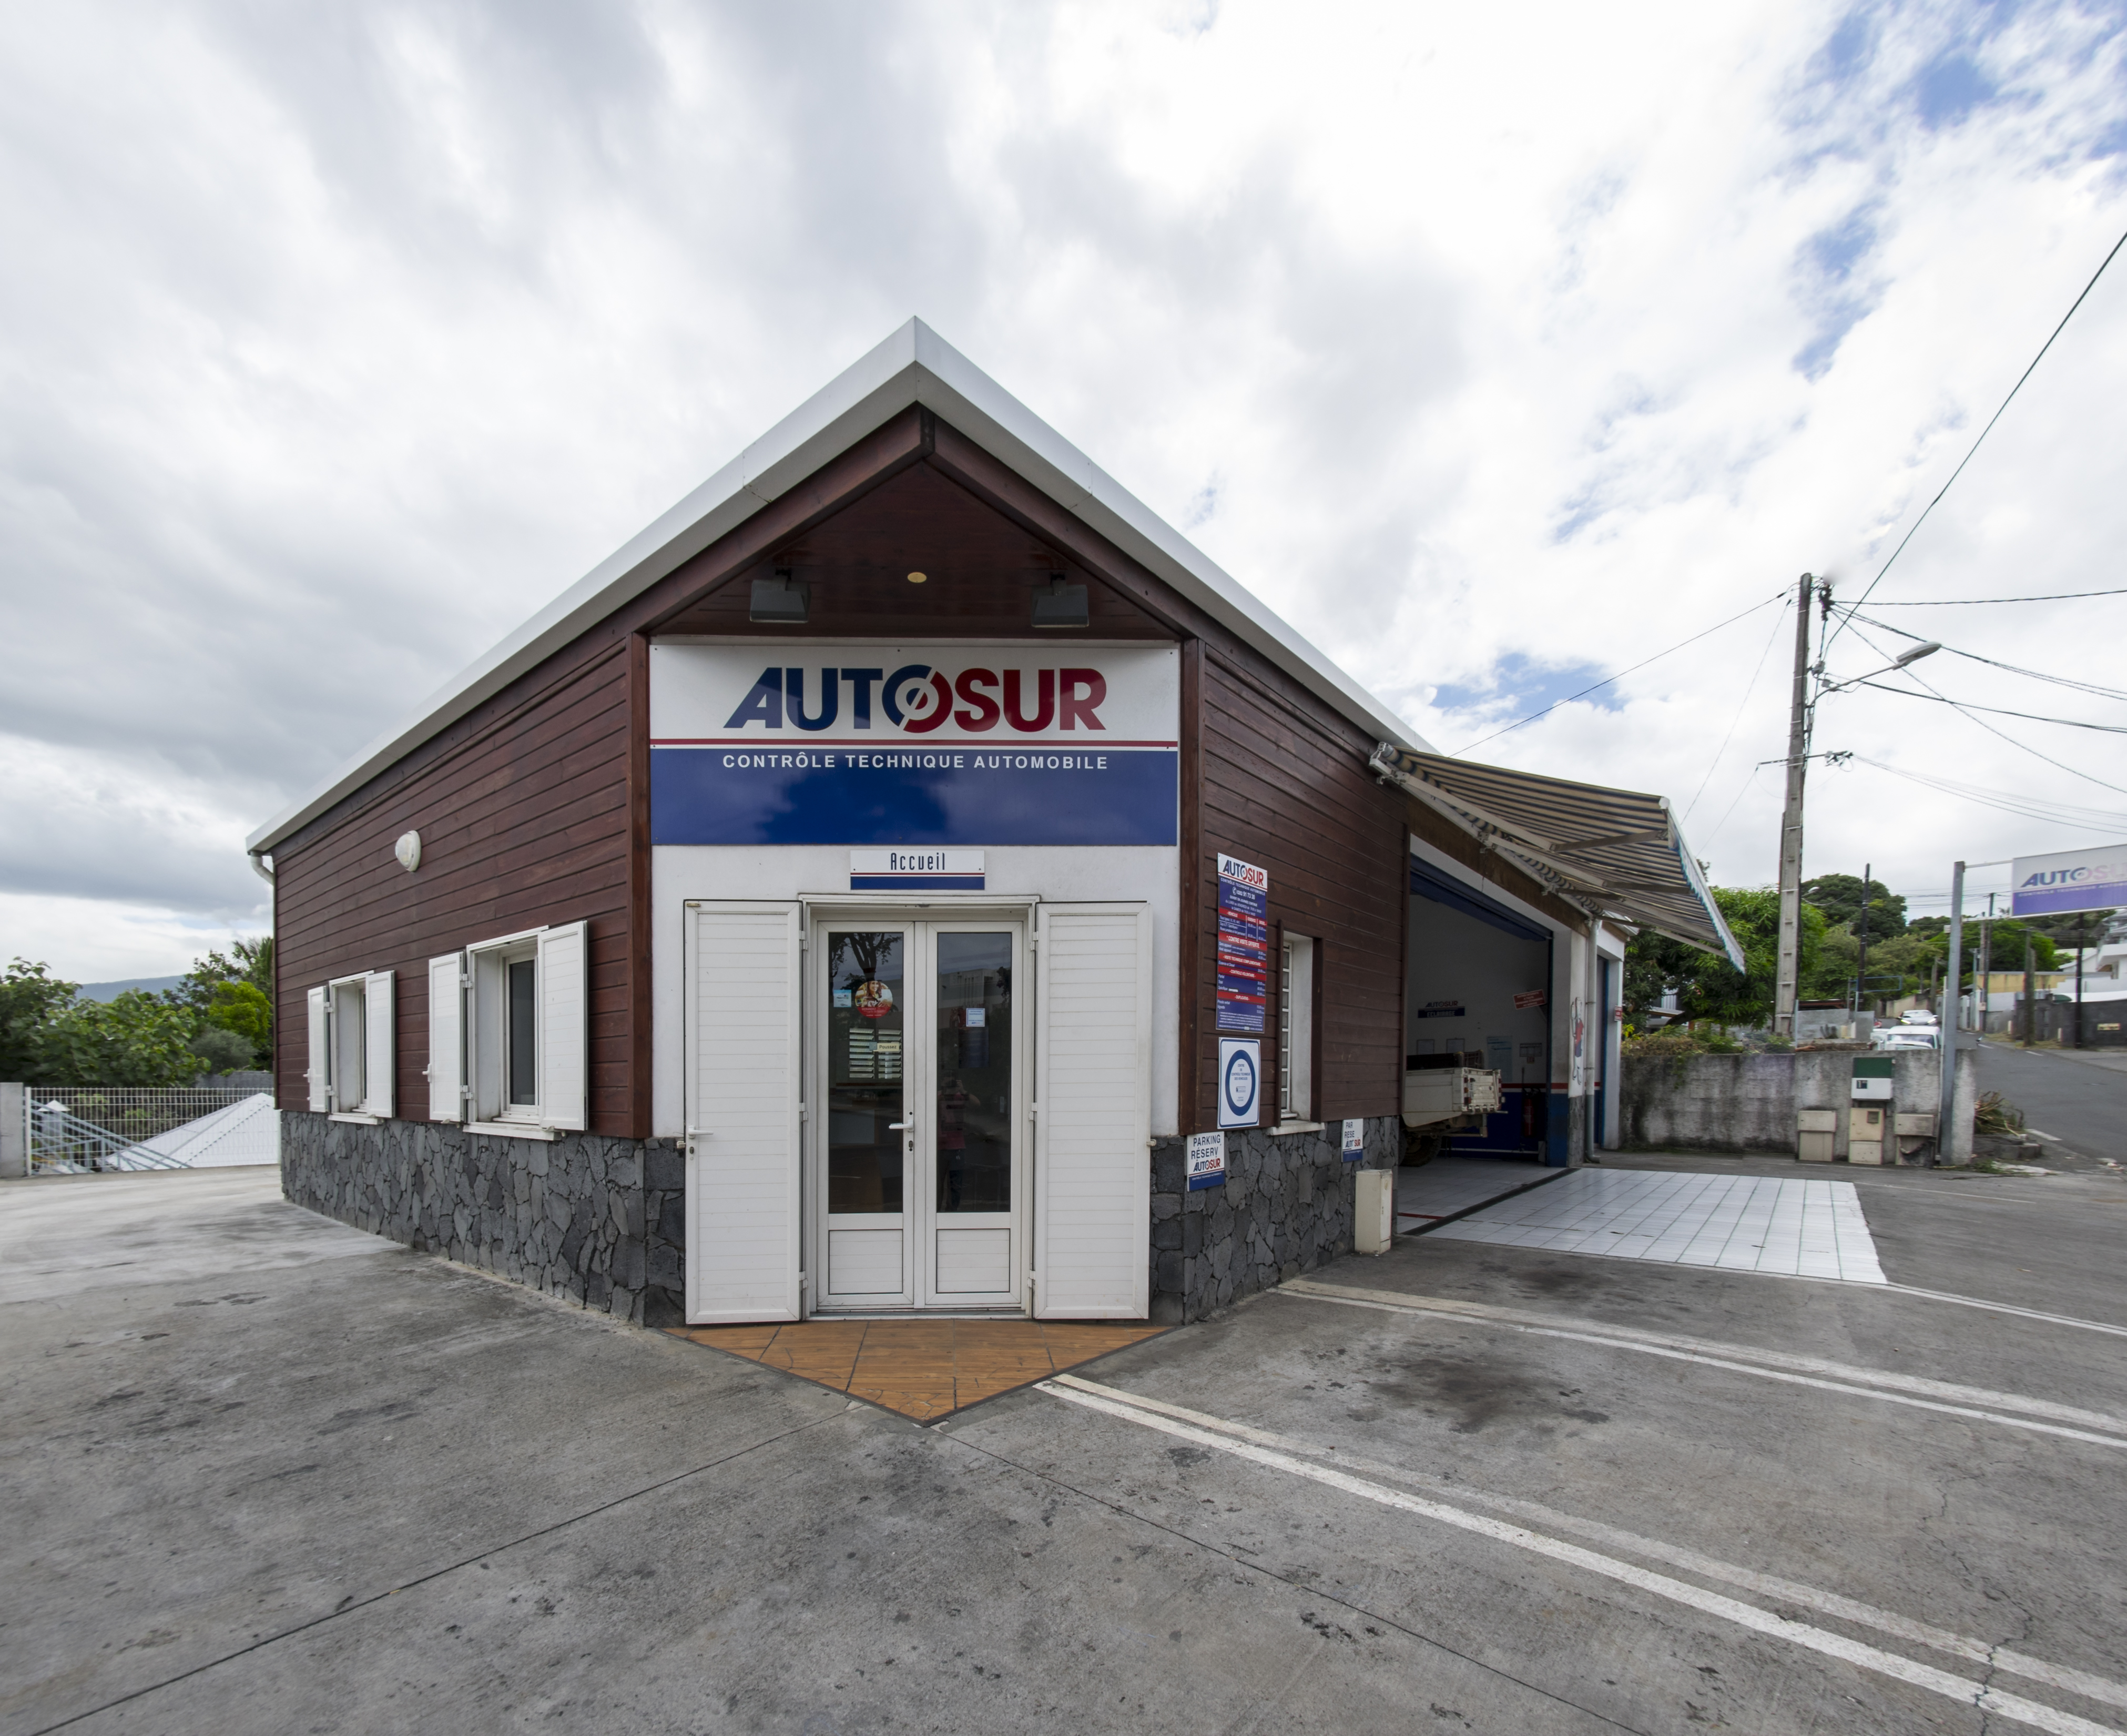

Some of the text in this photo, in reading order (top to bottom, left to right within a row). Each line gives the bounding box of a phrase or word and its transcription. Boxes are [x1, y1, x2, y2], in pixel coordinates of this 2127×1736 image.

[723, 664, 1106, 733] AUTOSUR
[723, 752, 1107, 769] CONTRÔLE TECHNIQUE AUTOMOBILE
[891, 852, 945, 870] Accueil
[1223, 860, 1264, 886] AUTOSUR
[1193, 1134, 1220, 1147] PARKING
[1193, 1158, 1220, 1172] AUTOSUR
